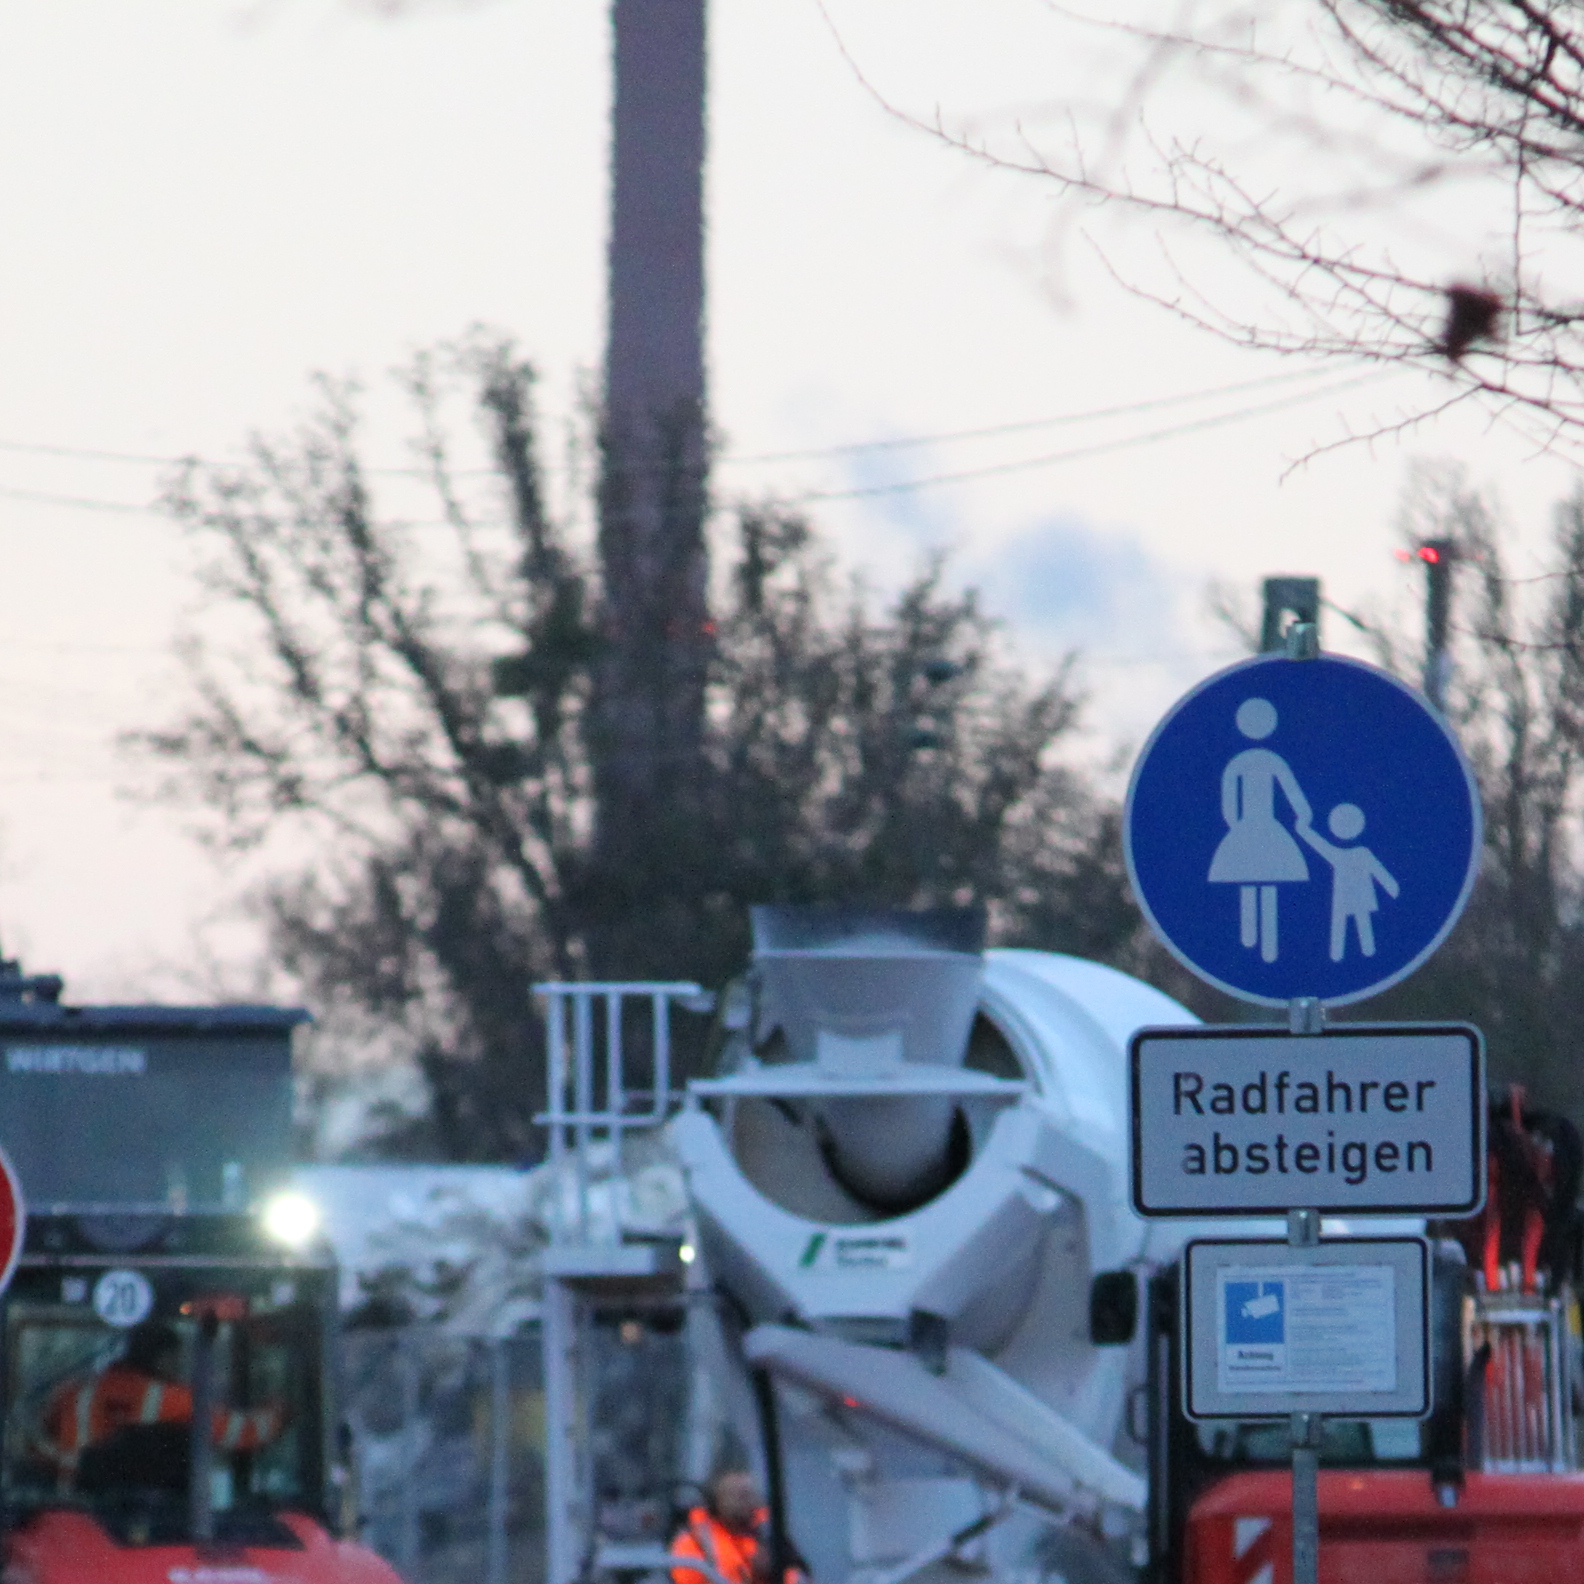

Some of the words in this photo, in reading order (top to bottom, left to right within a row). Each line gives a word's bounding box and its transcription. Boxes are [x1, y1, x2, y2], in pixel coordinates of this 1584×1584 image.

[1173, 1070, 1437, 1115] Radfahrer
[1182, 1130, 1434, 1185] absteigen
[106, 1281, 137, 1317] 20
